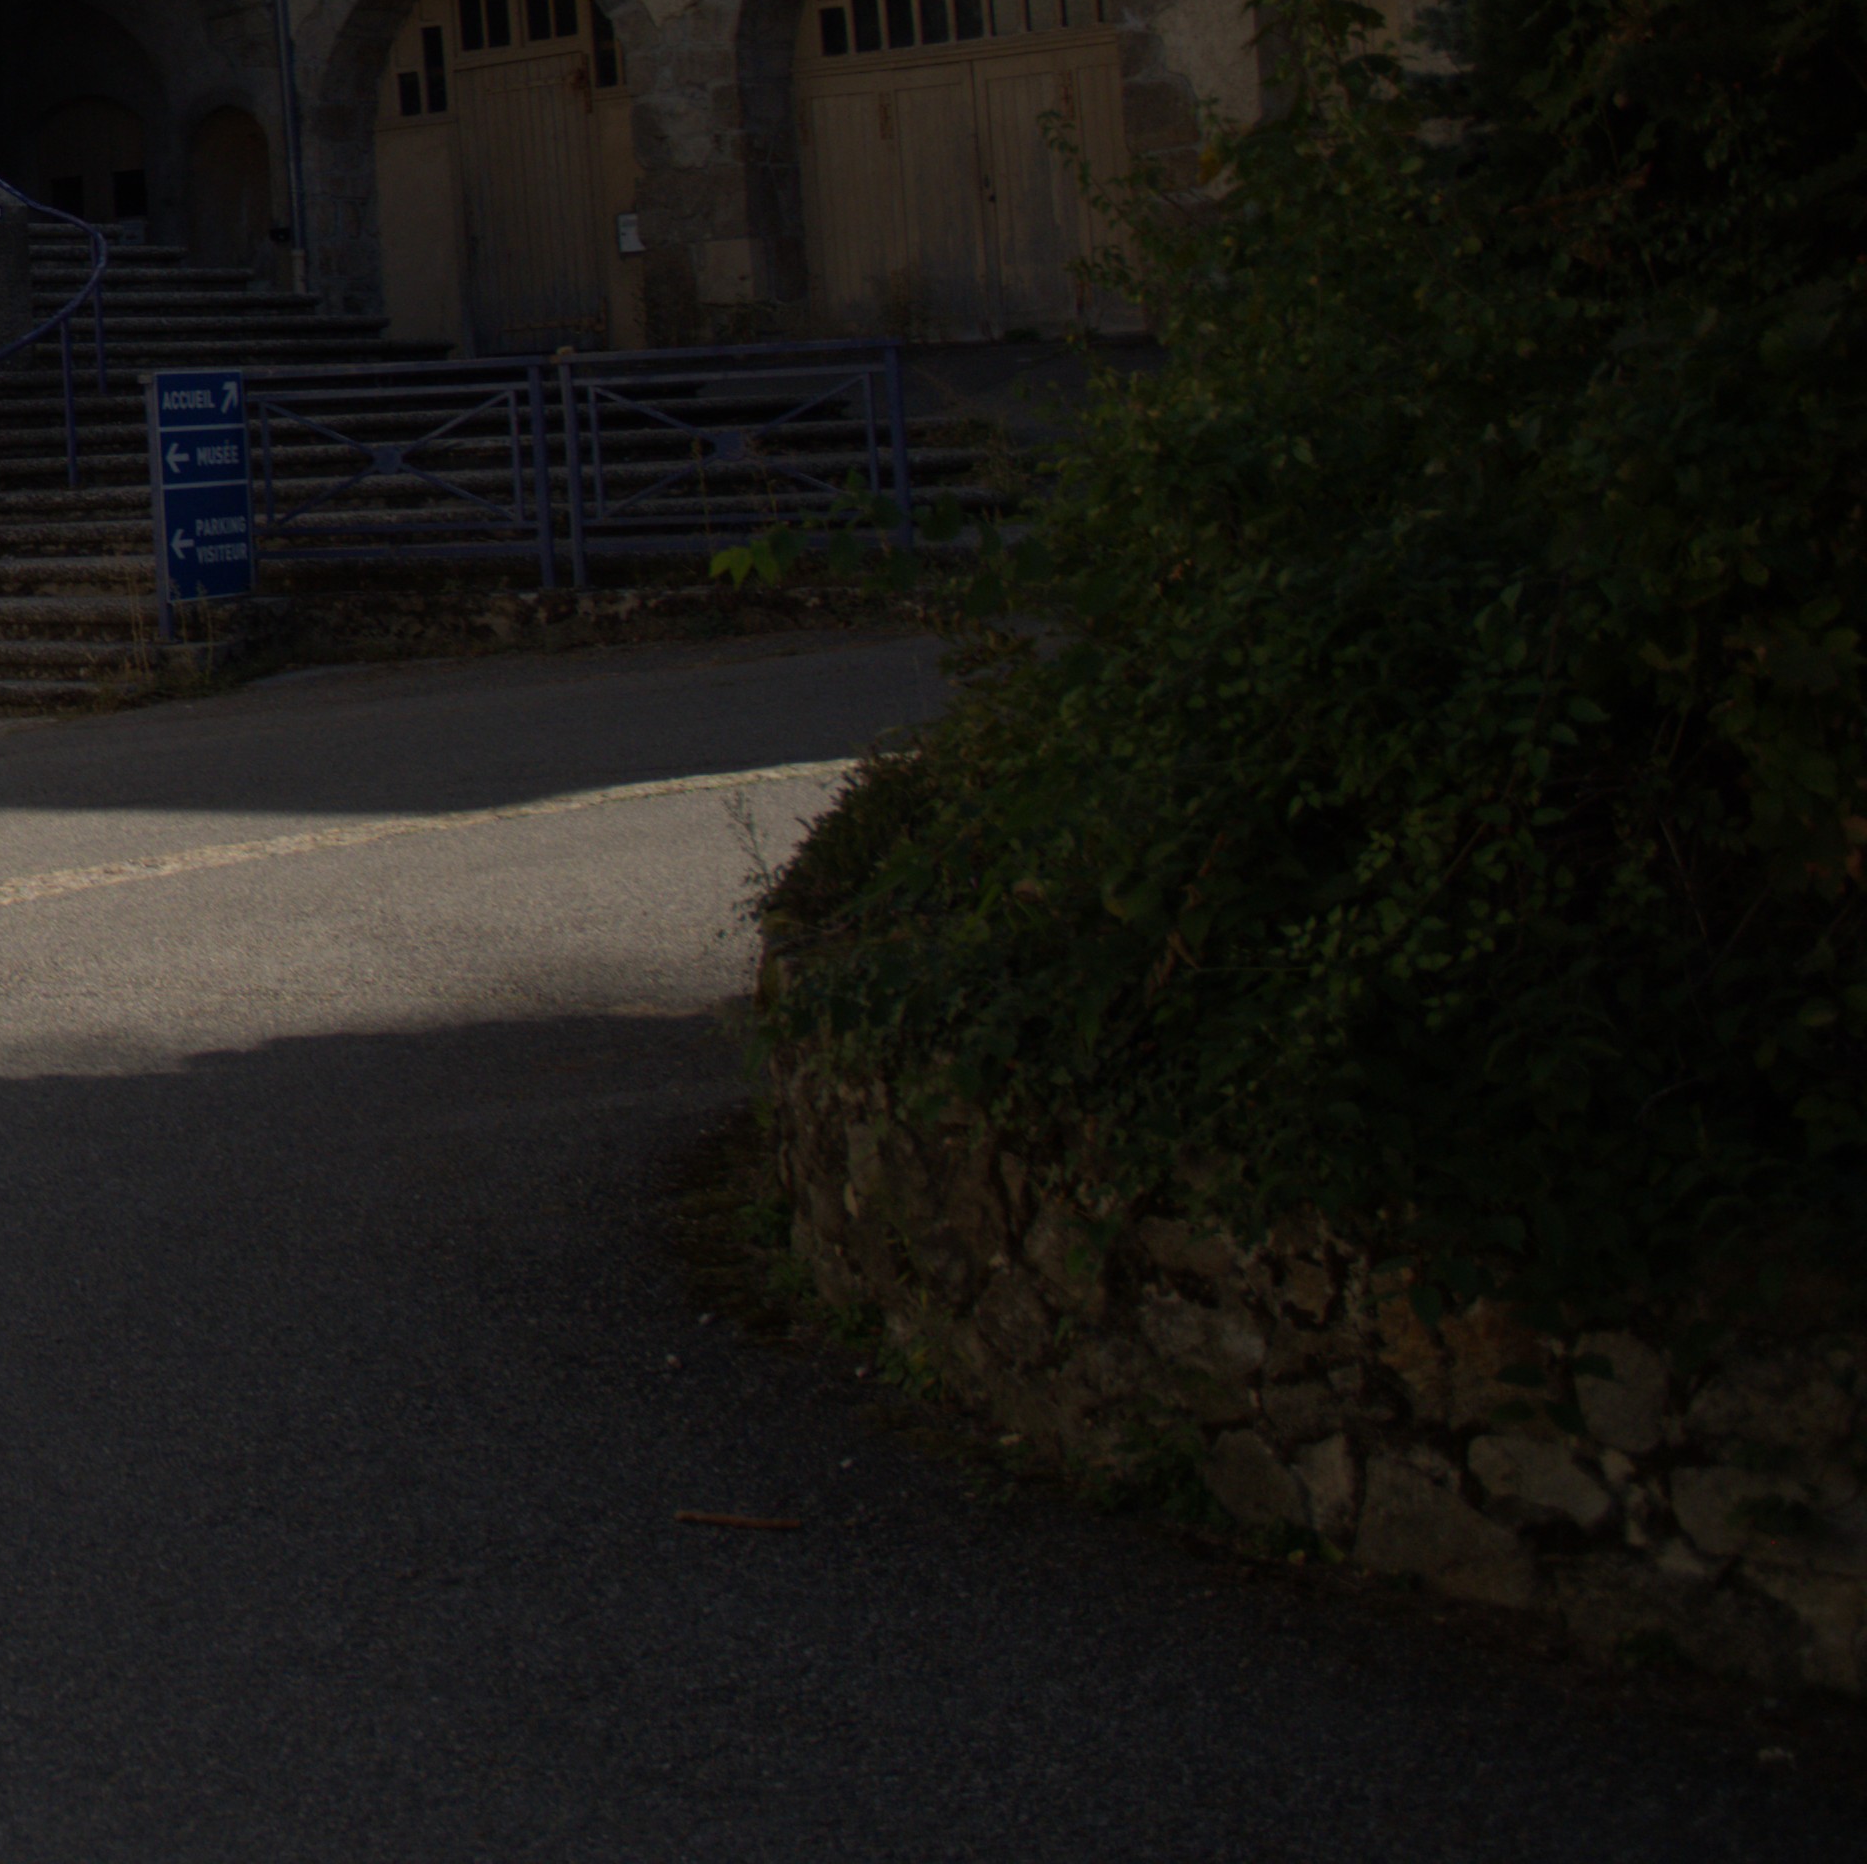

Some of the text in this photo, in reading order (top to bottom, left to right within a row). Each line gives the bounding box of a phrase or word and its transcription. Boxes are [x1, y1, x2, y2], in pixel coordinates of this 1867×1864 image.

[161, 389, 216, 410] ACCUEIL
[195, 439, 240, 467] MUSÉE
[195, 515, 247, 537] PARKING
[195, 542, 248, 565] VISITEUR
